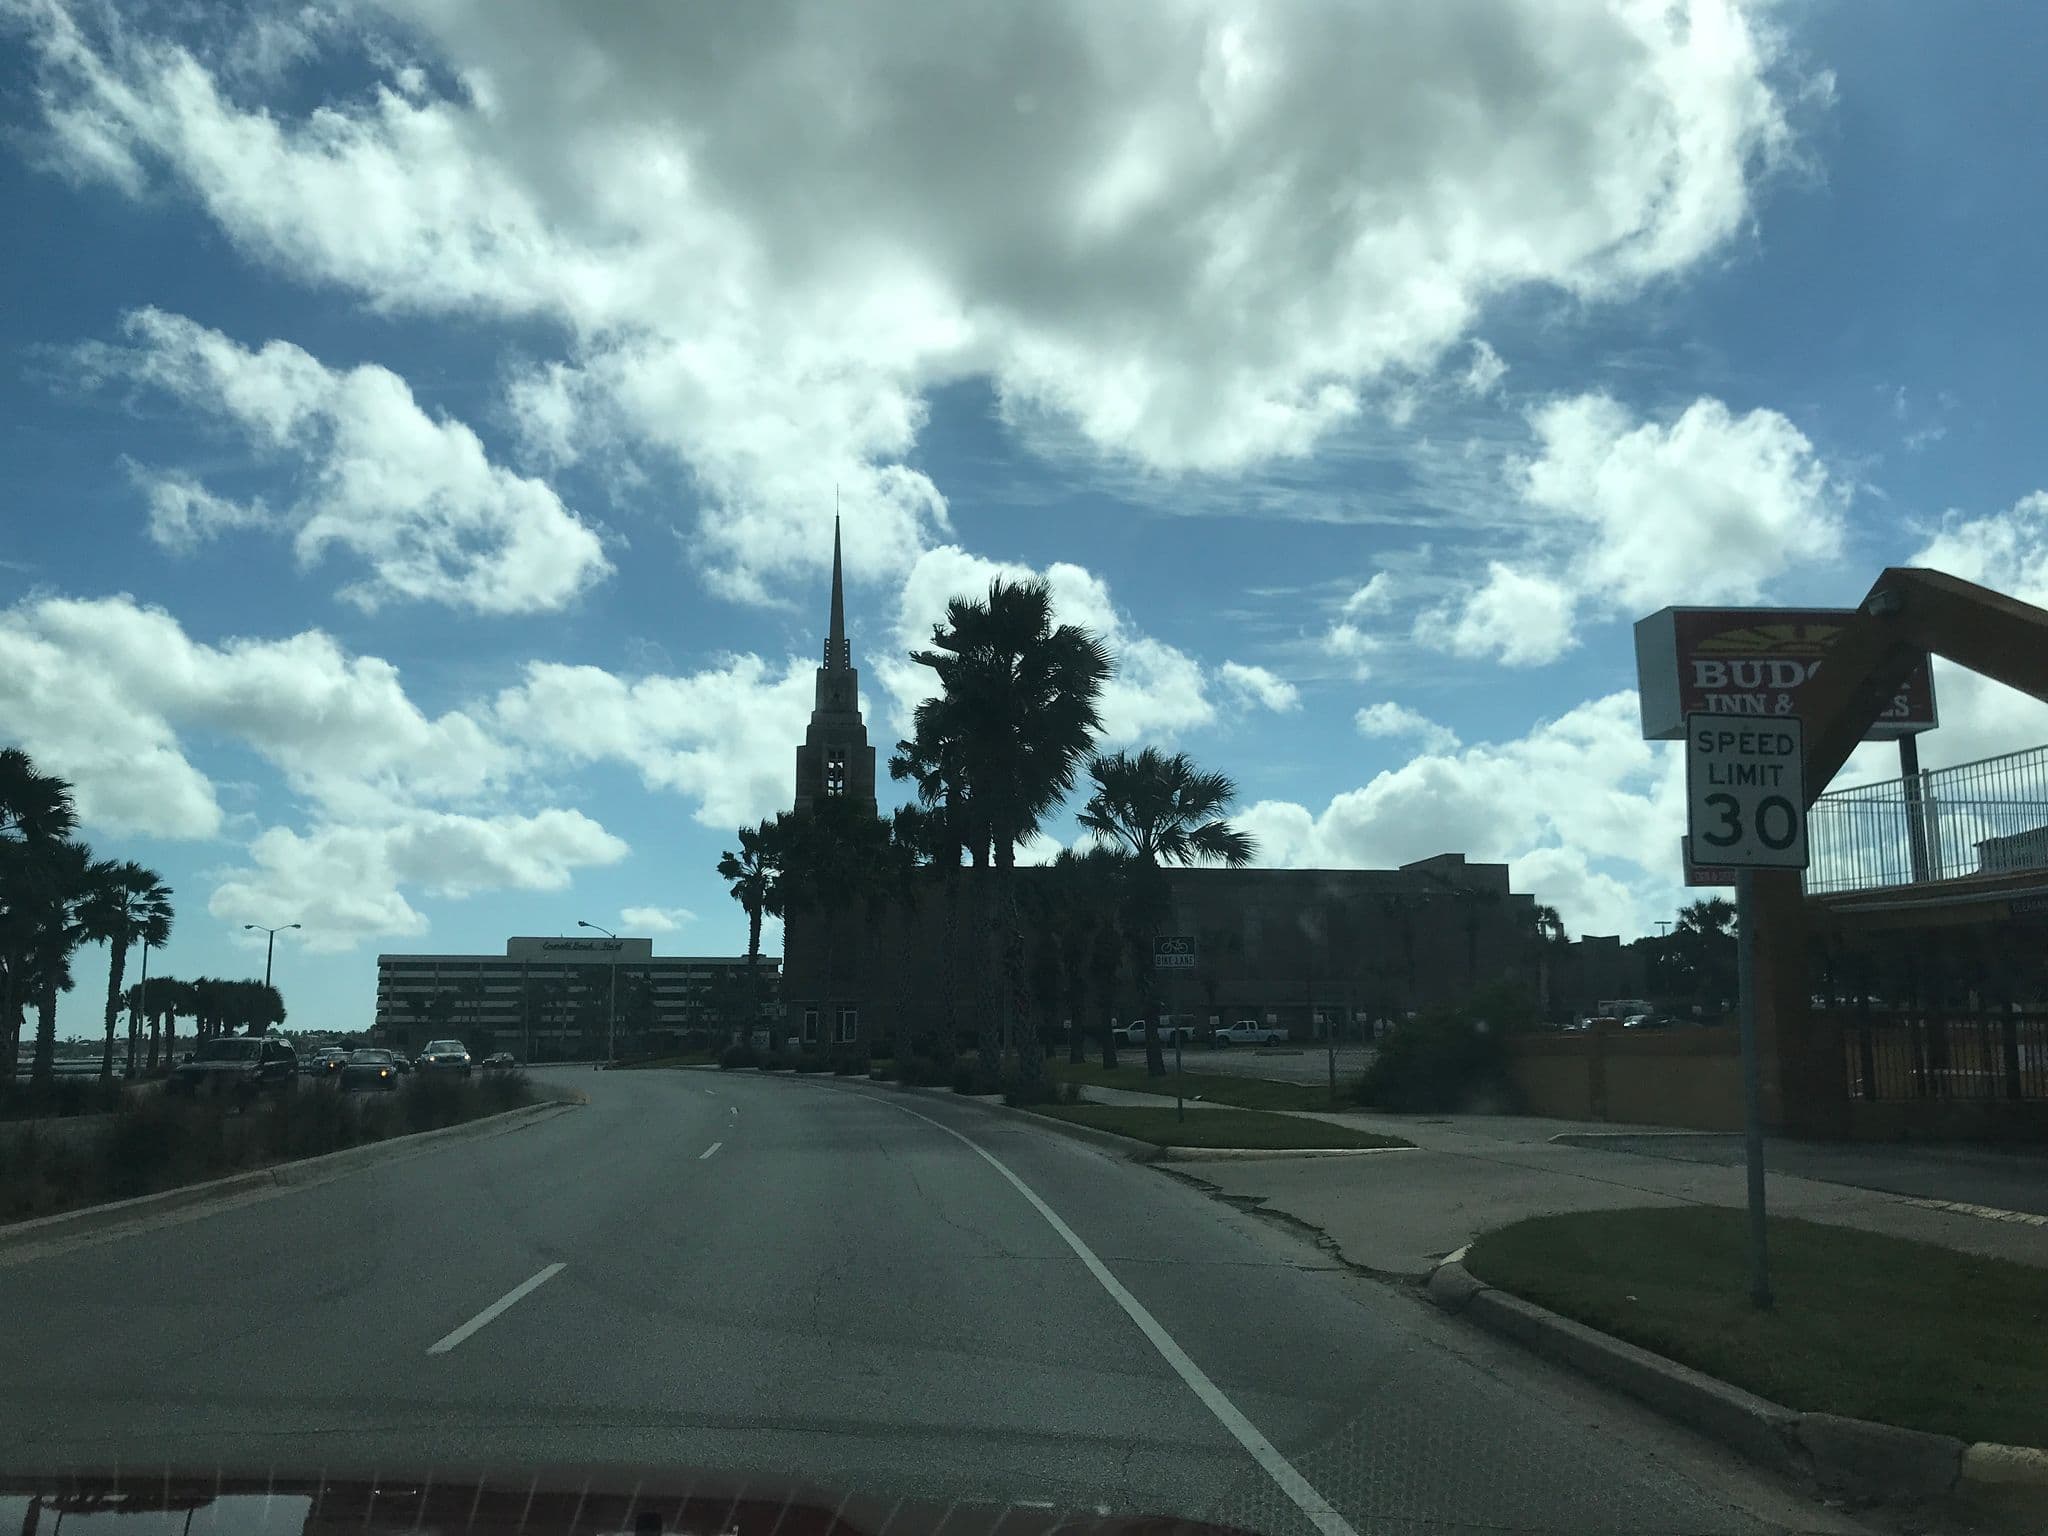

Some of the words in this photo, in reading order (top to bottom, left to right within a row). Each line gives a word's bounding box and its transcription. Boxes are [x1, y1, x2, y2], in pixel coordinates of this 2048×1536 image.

[1705, 693, 1768, 714] INN
[1774, 693, 1795, 714] &
[1698, 730, 1795, 756] SPEED
[1708, 762, 1784, 787] LIMIT
[1703, 792, 1798, 851] 30
